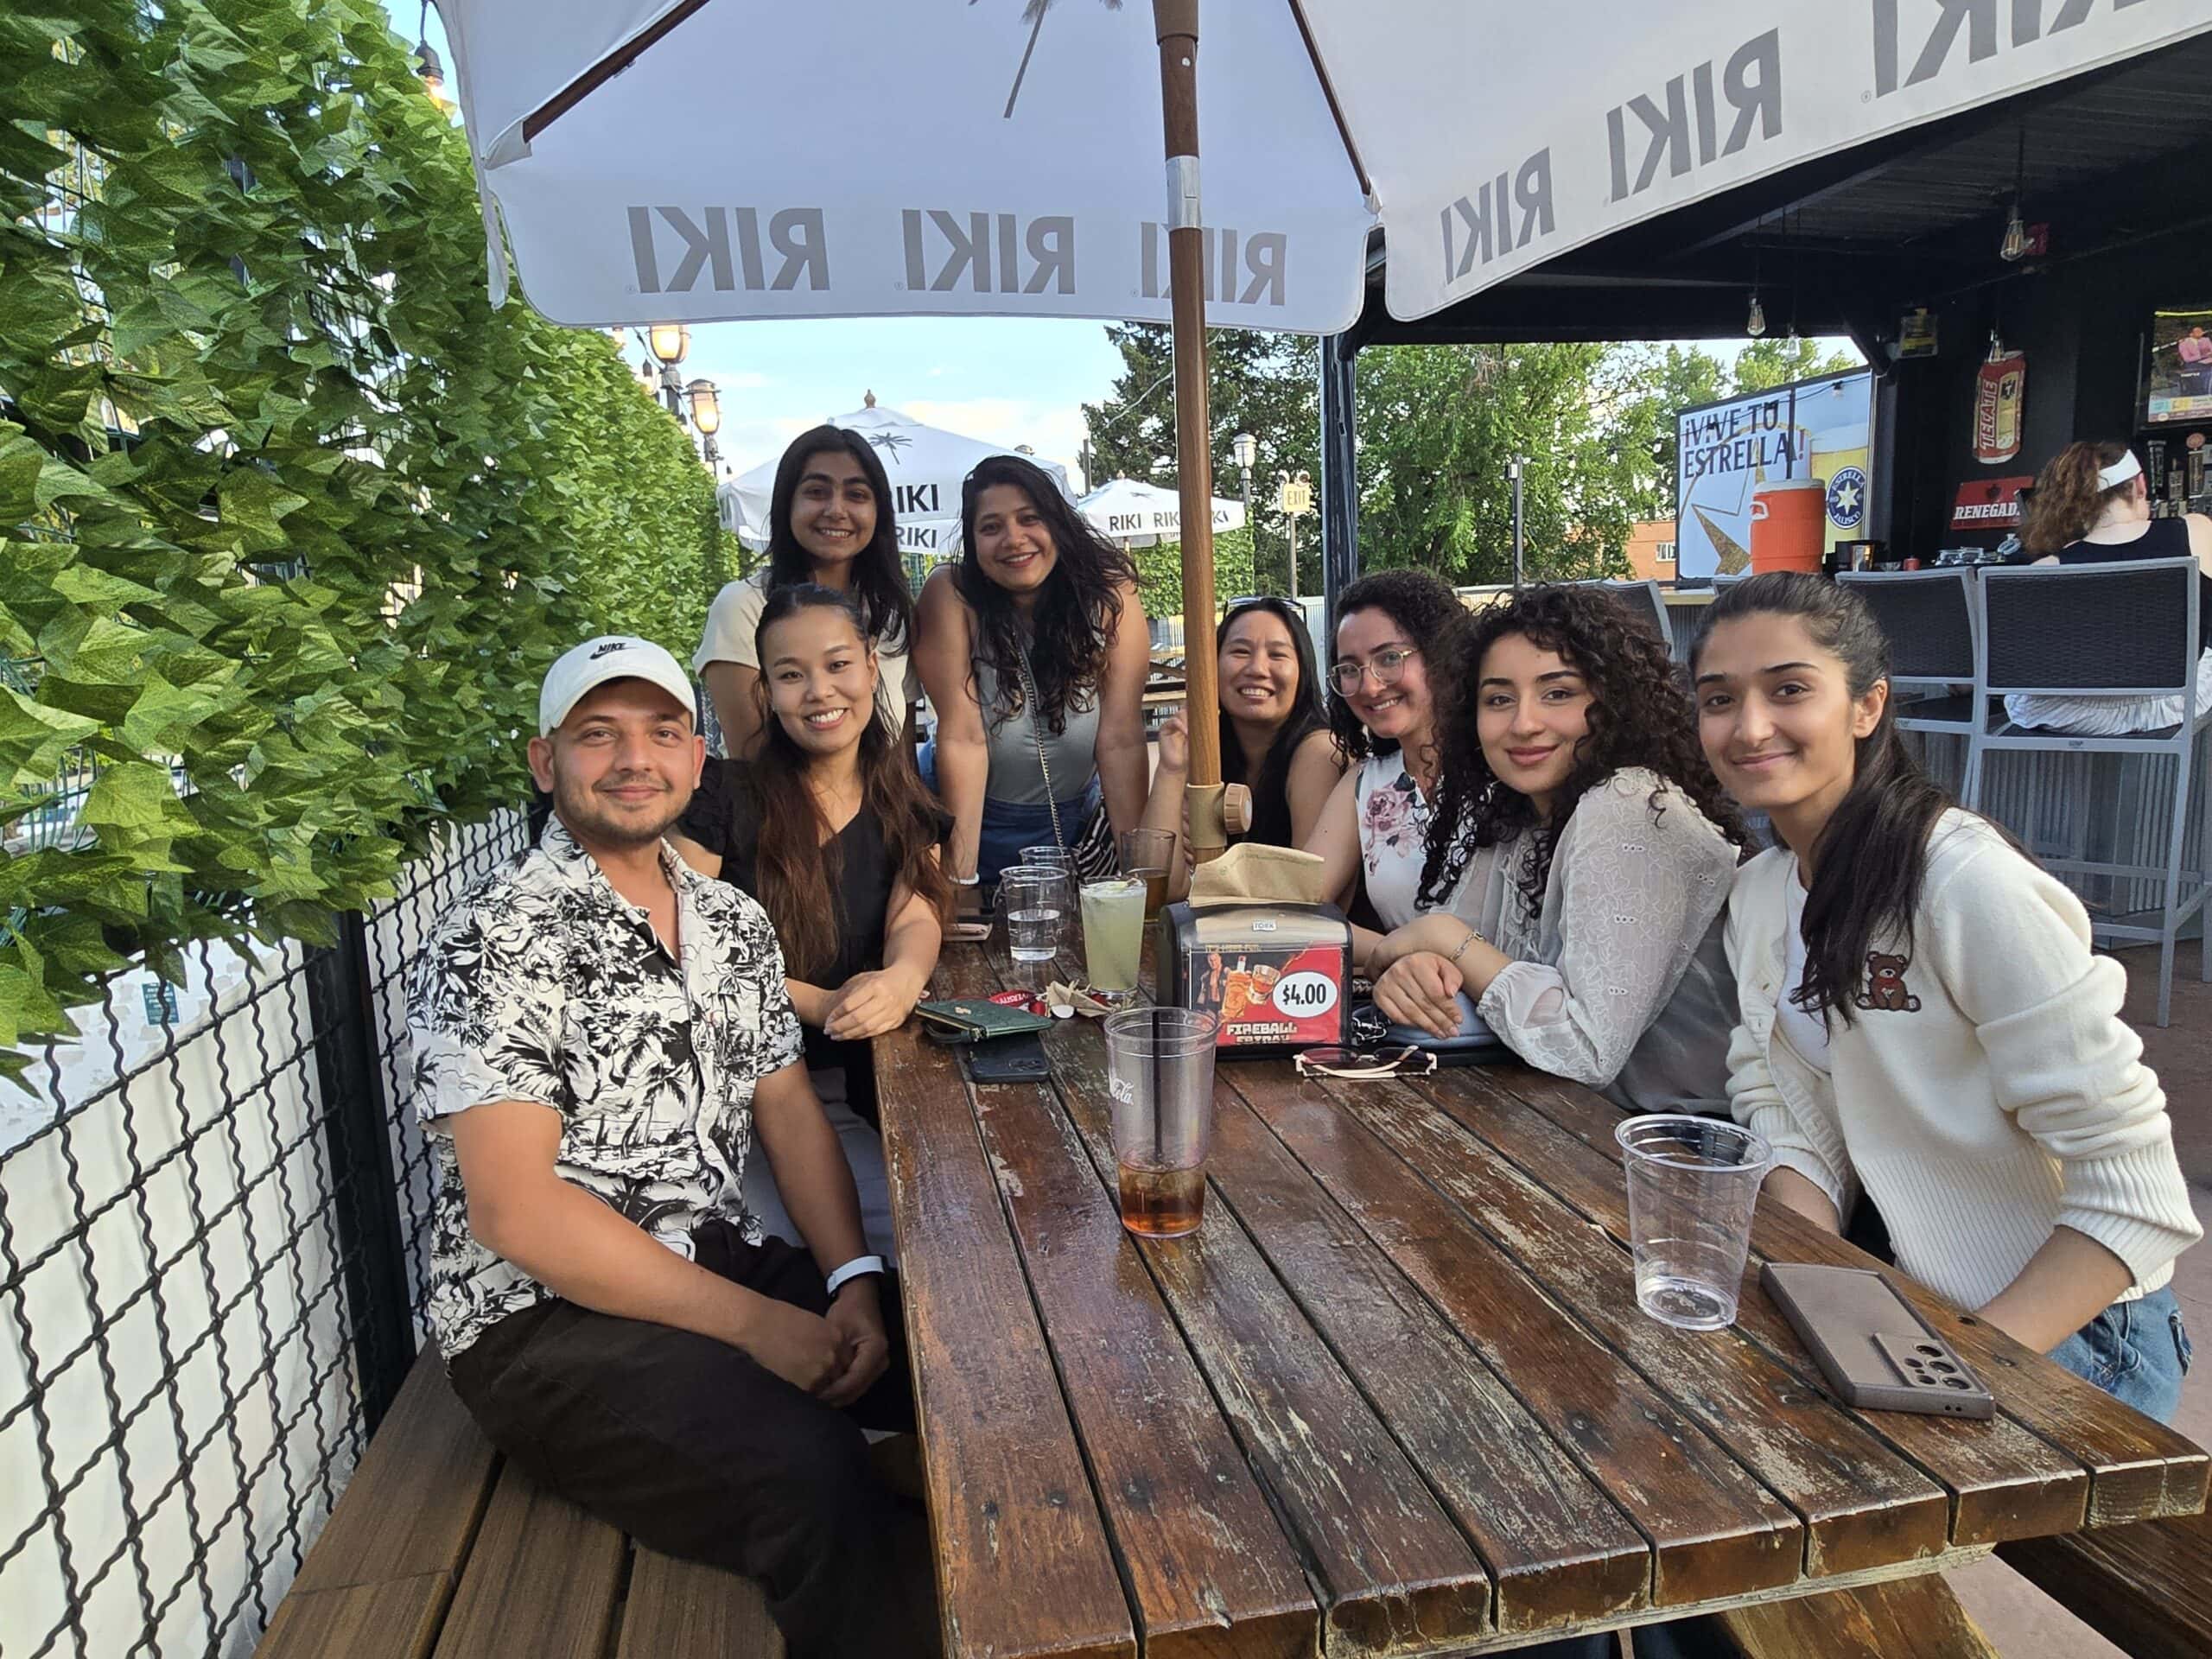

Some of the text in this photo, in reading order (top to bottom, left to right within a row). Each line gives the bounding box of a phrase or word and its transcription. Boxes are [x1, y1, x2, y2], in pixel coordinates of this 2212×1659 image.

[1979, 379, 1998, 449] TECATE
[896, 484, 939, 514] IKI
[1287, 490, 1306, 505] EXIT
[1109, 510, 1229, 531] RIKI RIK KI
[1954, 502, 2020, 520] RENEGAD
[598, 642, 626, 652] NIKE
[1282, 983, 1327, 1006] $4.00
[1227, 1021, 1298, 1036] FIREBALL
